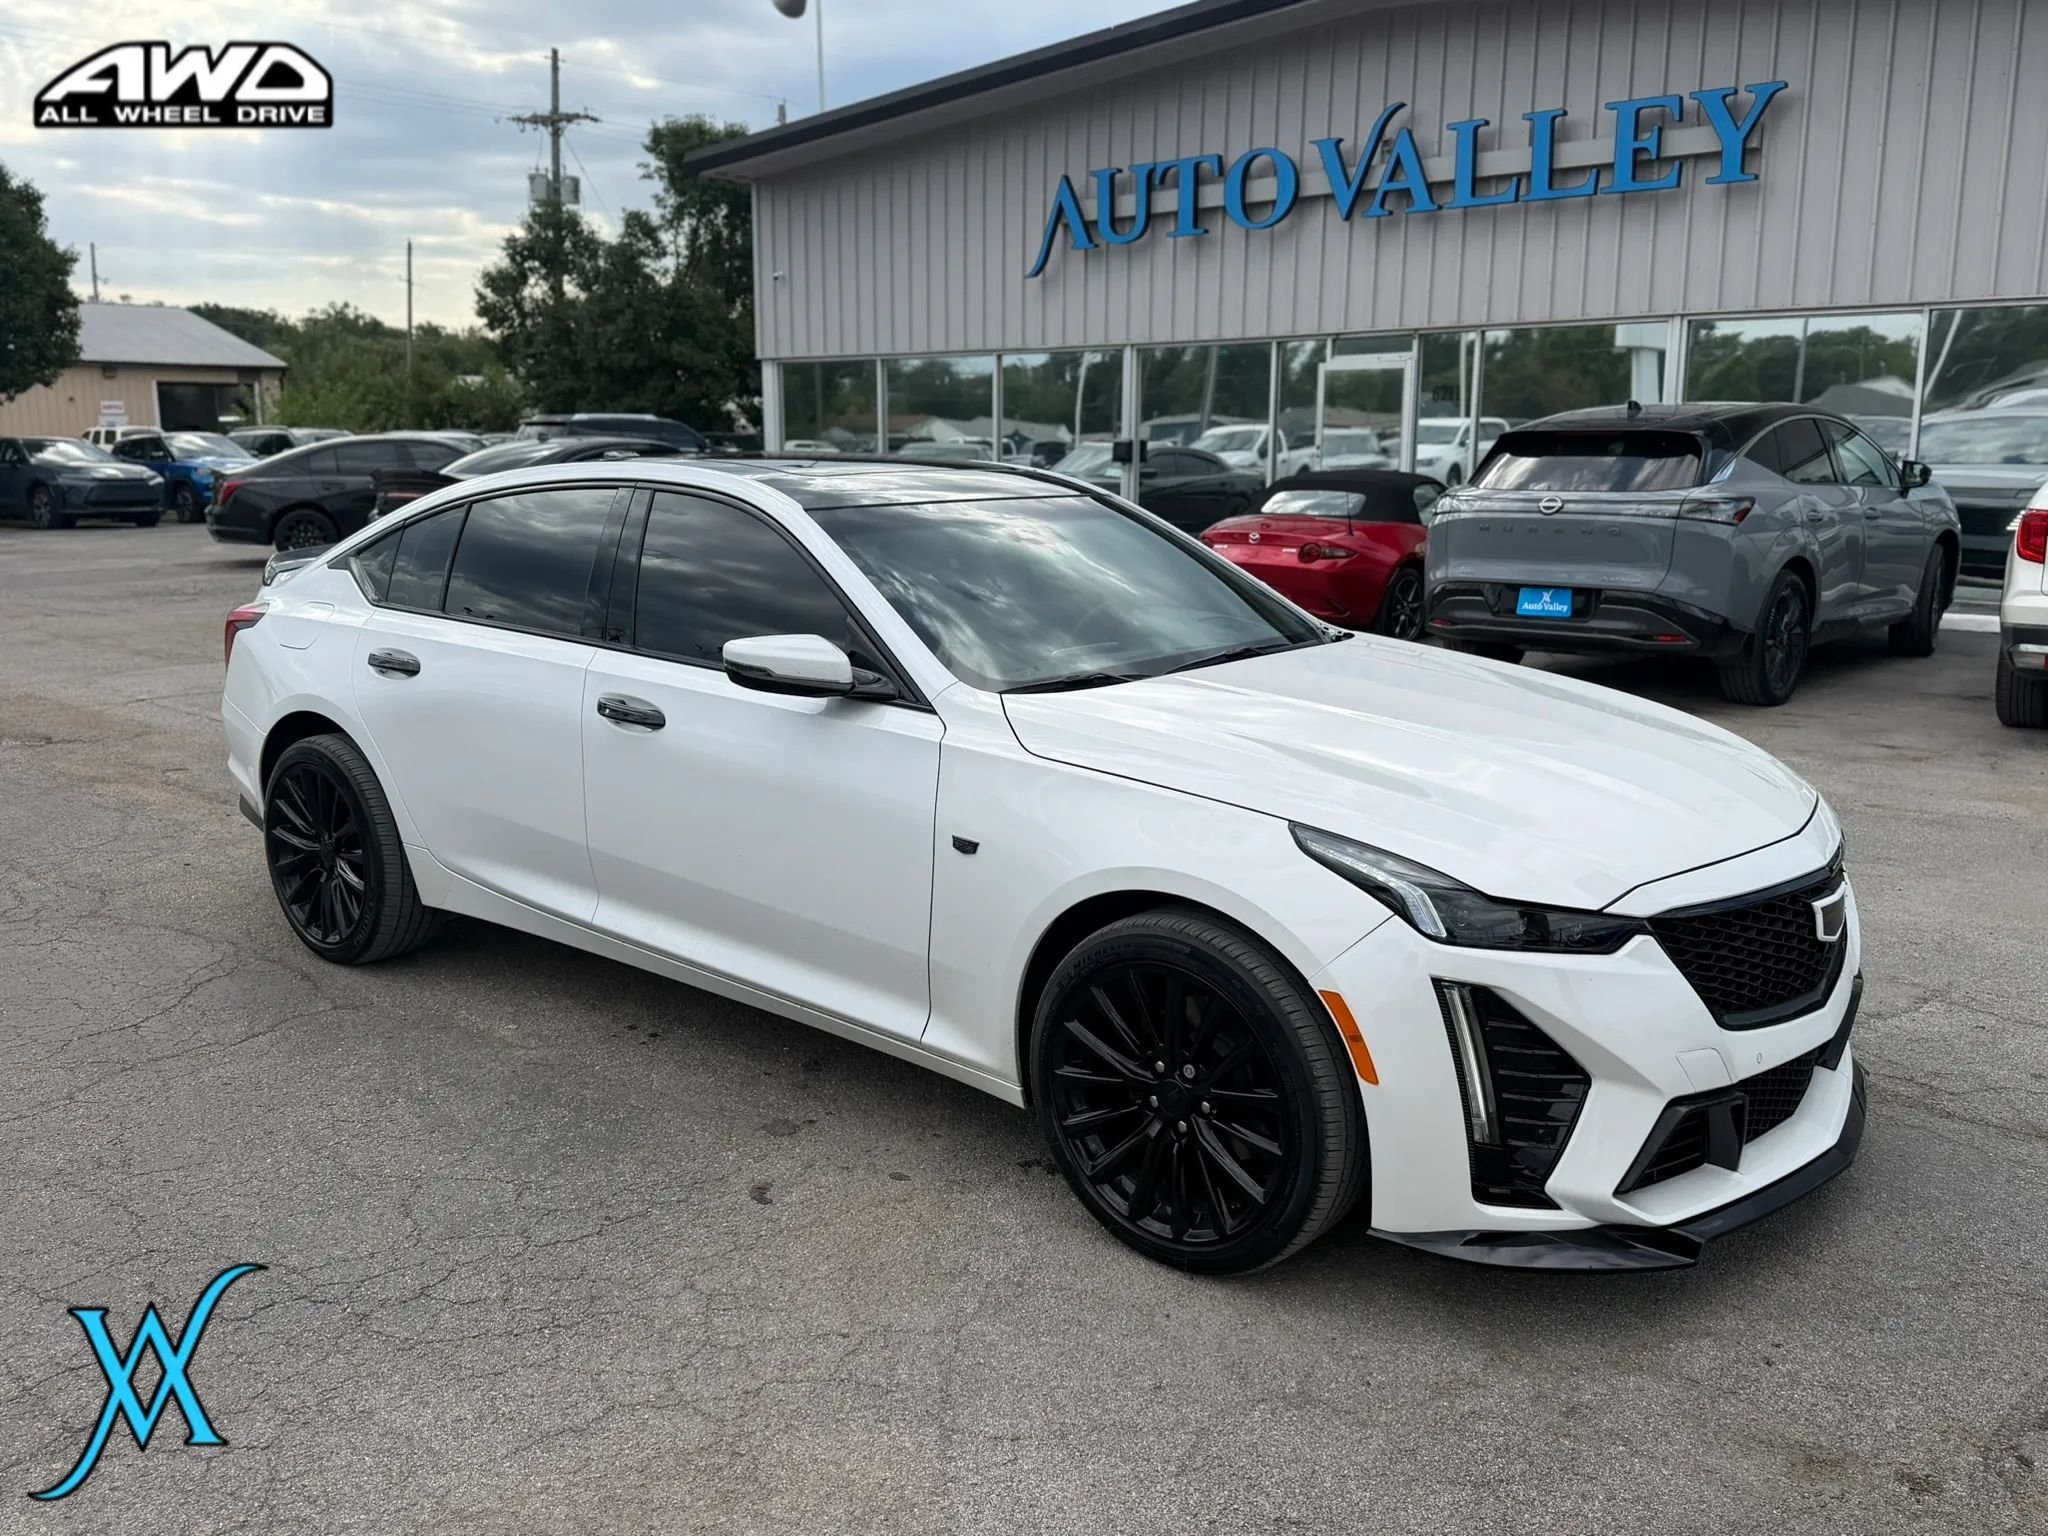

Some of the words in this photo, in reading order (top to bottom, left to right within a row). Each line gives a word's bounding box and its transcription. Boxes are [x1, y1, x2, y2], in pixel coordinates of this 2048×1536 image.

[1025, 146, 1299, 278] AUTO
[1310, 80, 1788, 222] VALLEY
[1521, 602, 1543, 611] Auto
[1543, 602, 1568, 613] Valley
